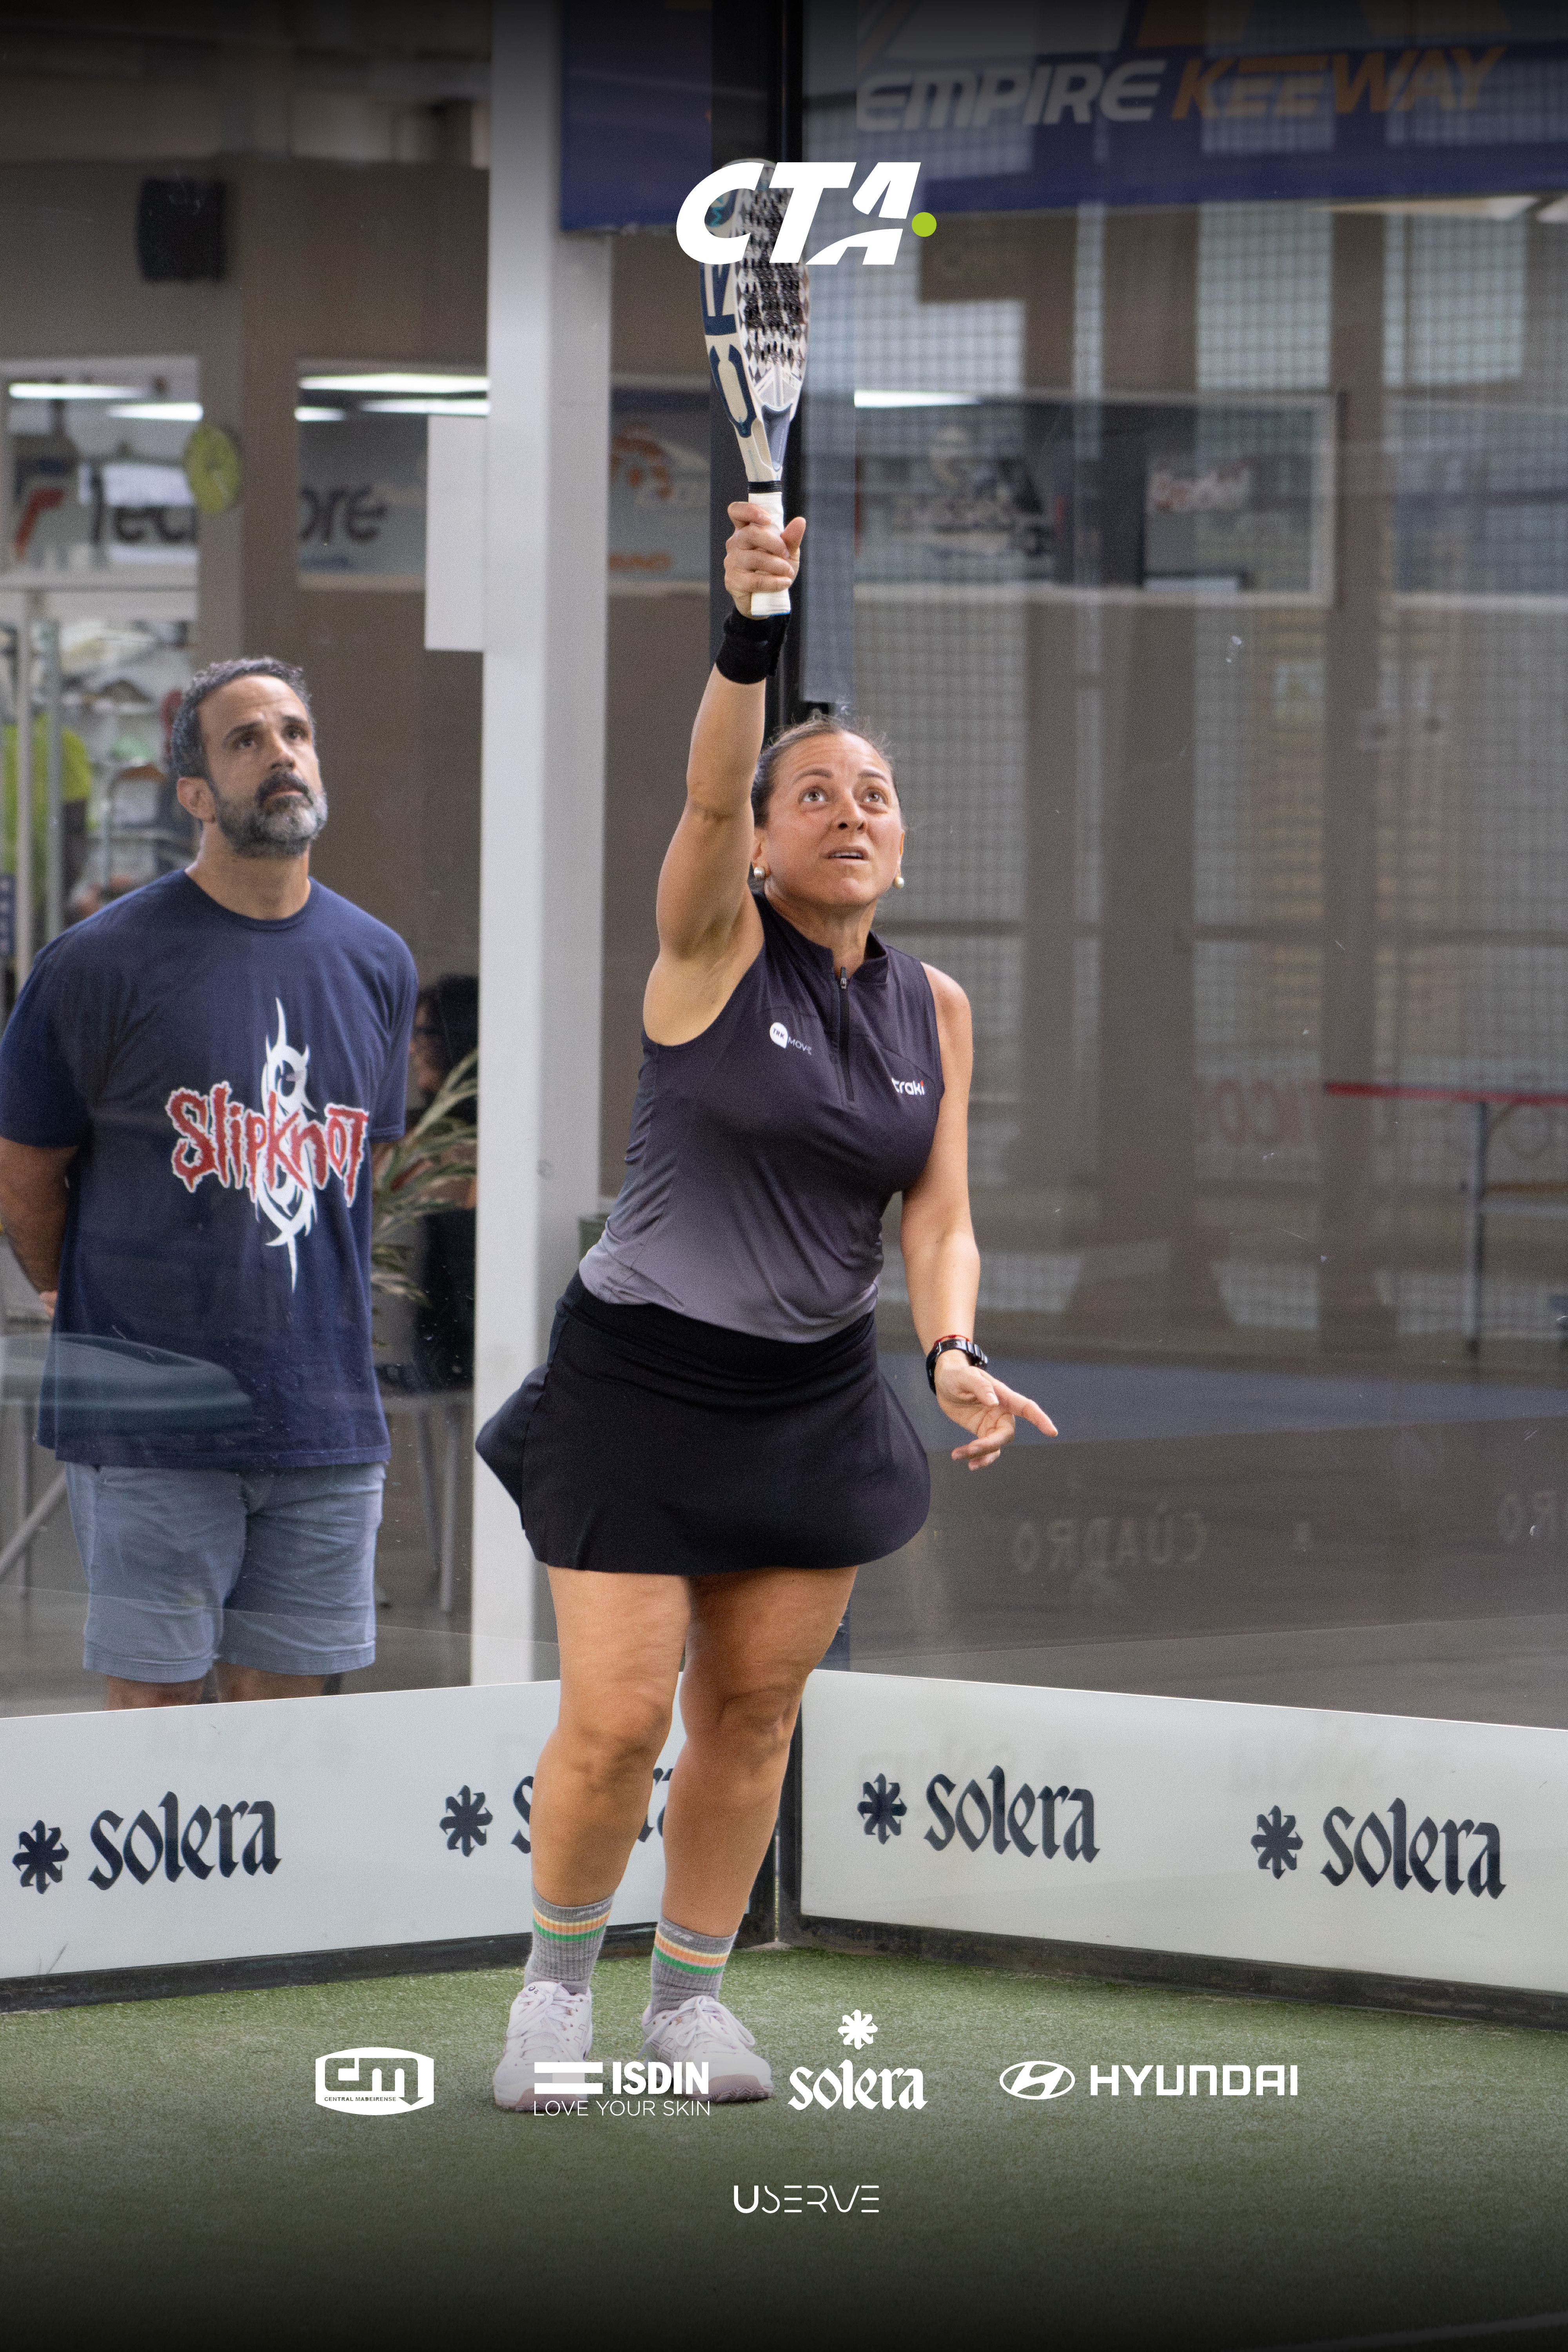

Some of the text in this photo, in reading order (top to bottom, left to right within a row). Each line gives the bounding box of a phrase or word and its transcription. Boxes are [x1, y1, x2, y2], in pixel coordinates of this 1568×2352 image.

[857, 47, 1508, 132] EMPIRE KEEWAY
[891, 1077, 926, 1095] traki
[88, 1791, 282, 1890] solera
[924, 1766, 1100, 1864] solera
[1320, 1798, 1507, 1900] solera
